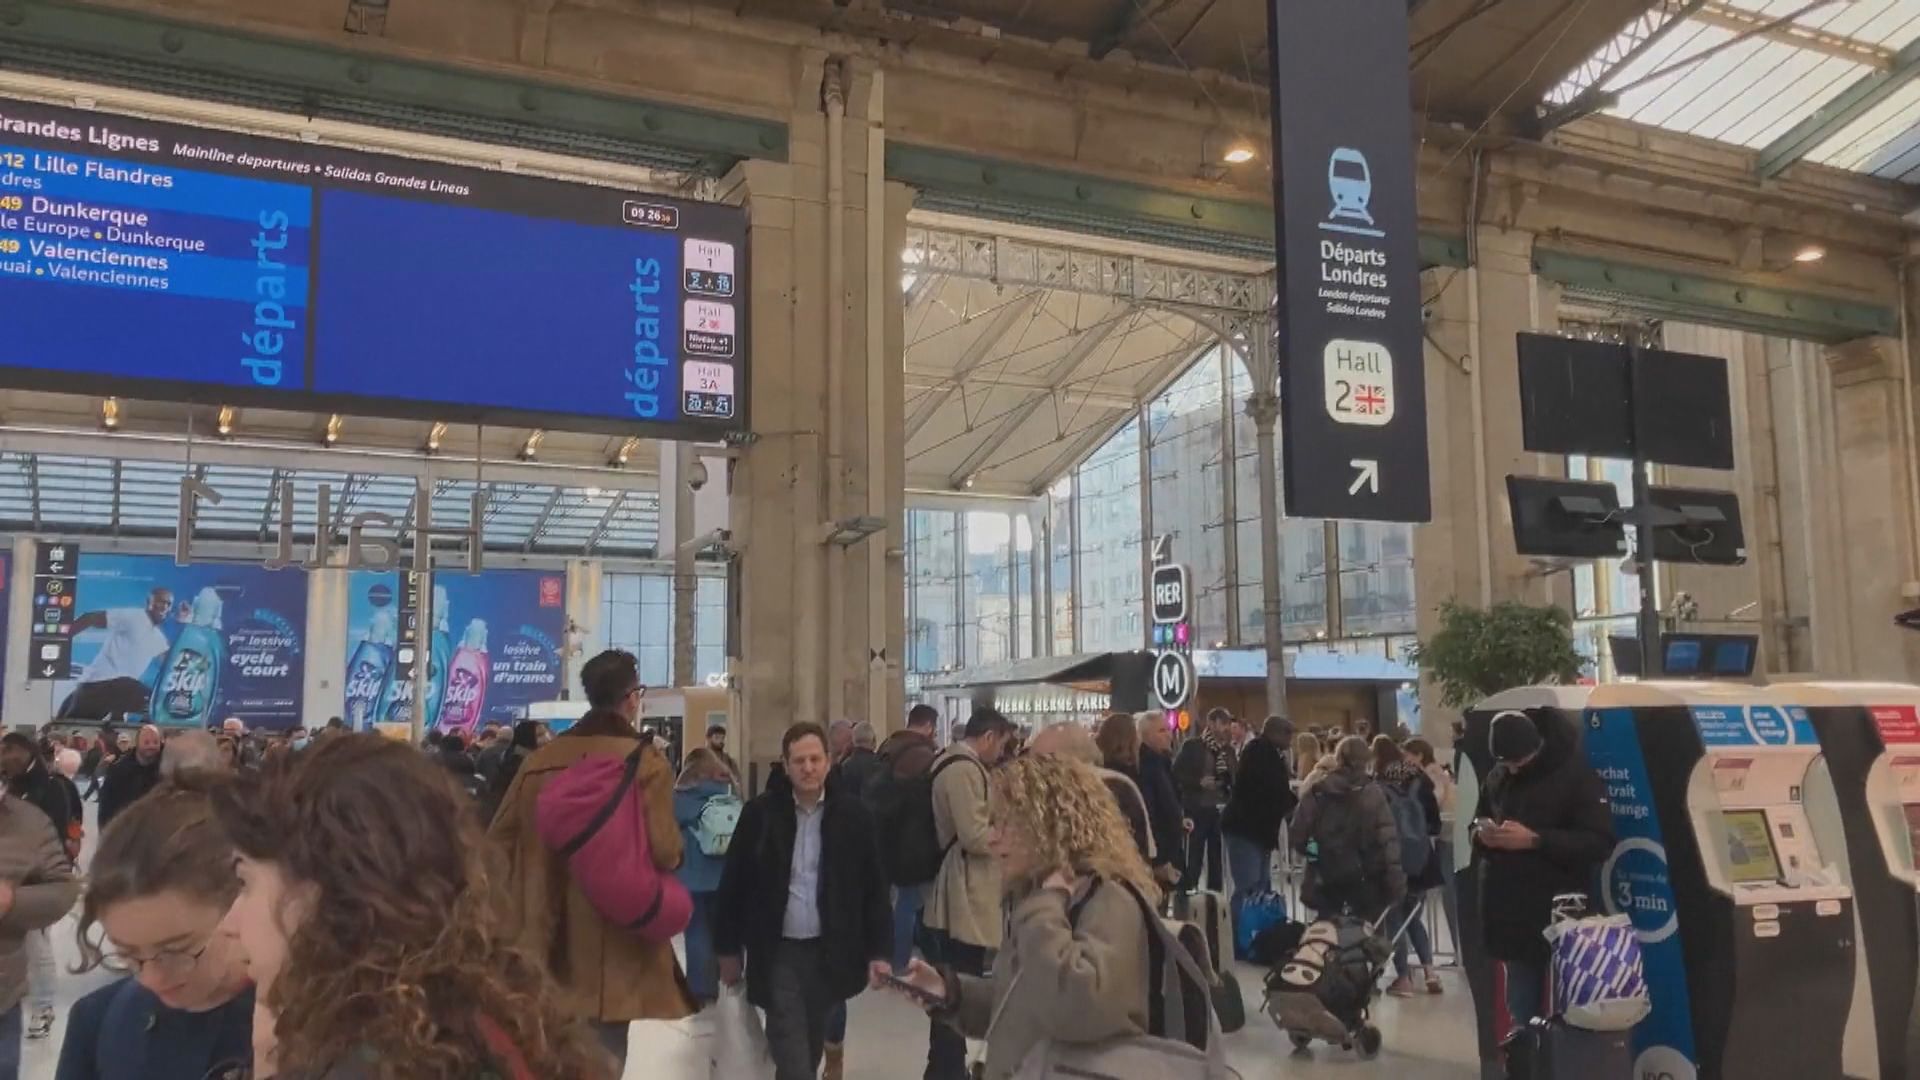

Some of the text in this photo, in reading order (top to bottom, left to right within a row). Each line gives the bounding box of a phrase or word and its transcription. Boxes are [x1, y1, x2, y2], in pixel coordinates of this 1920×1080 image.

[0, 113, 159, 152] randes Lignes
[0, 153, 173, 188] 12 Lille Flandres
[172, 142, 234, 164] Mainline
[237, 152, 311, 174] departures
[324, 165, 372, 183] Salidas
[375, 172, 427, 190] Grandes
[1, 172, 42, 189] dres
[32, 196, 149, 227] Dunkerque
[631, 207, 645, 220] 09
[0, 215, 205, 253] le Europe Dunkerque
[29, 239, 169, 270] Valenciennes
[698, 244, 721, 257] Hall
[1320, 240, 1386, 266] Départs
[707, 258, 712, 269] 1
[0, 260, 169, 289] uai Valenciennes
[1321, 262, 1387, 287] Londres
[241, 209, 295, 386] départs
[1318, 287, 1390, 305] London departures
[698, 304, 721, 317] Hall
[1327, 302, 1386, 319] Salidas Londres
[698, 317, 706, 328] 2
[625, 257, 668, 418] départs
[1336, 347, 1381, 374] Hall
[697, 367, 721, 378] Hall
[700, 378, 718, 390] 3A
[1335, 380, 1352, 412] 2
[1156, 581, 1181, 605] RER
[230, 651, 275, 667] cycle
[492, 660, 547, 672] un train
[242, 663, 289, 677] court
[493, 671, 555, 684] d'avance
[1162, 663, 1180, 696] M
[994, 696, 1031, 713] PIERRE
[1076, 694, 1111, 710] PARIS
[1591, 712, 1601, 728] 6
[1607, 784, 1635, 798] trait
[1618, 881, 1668, 912] 3 min
